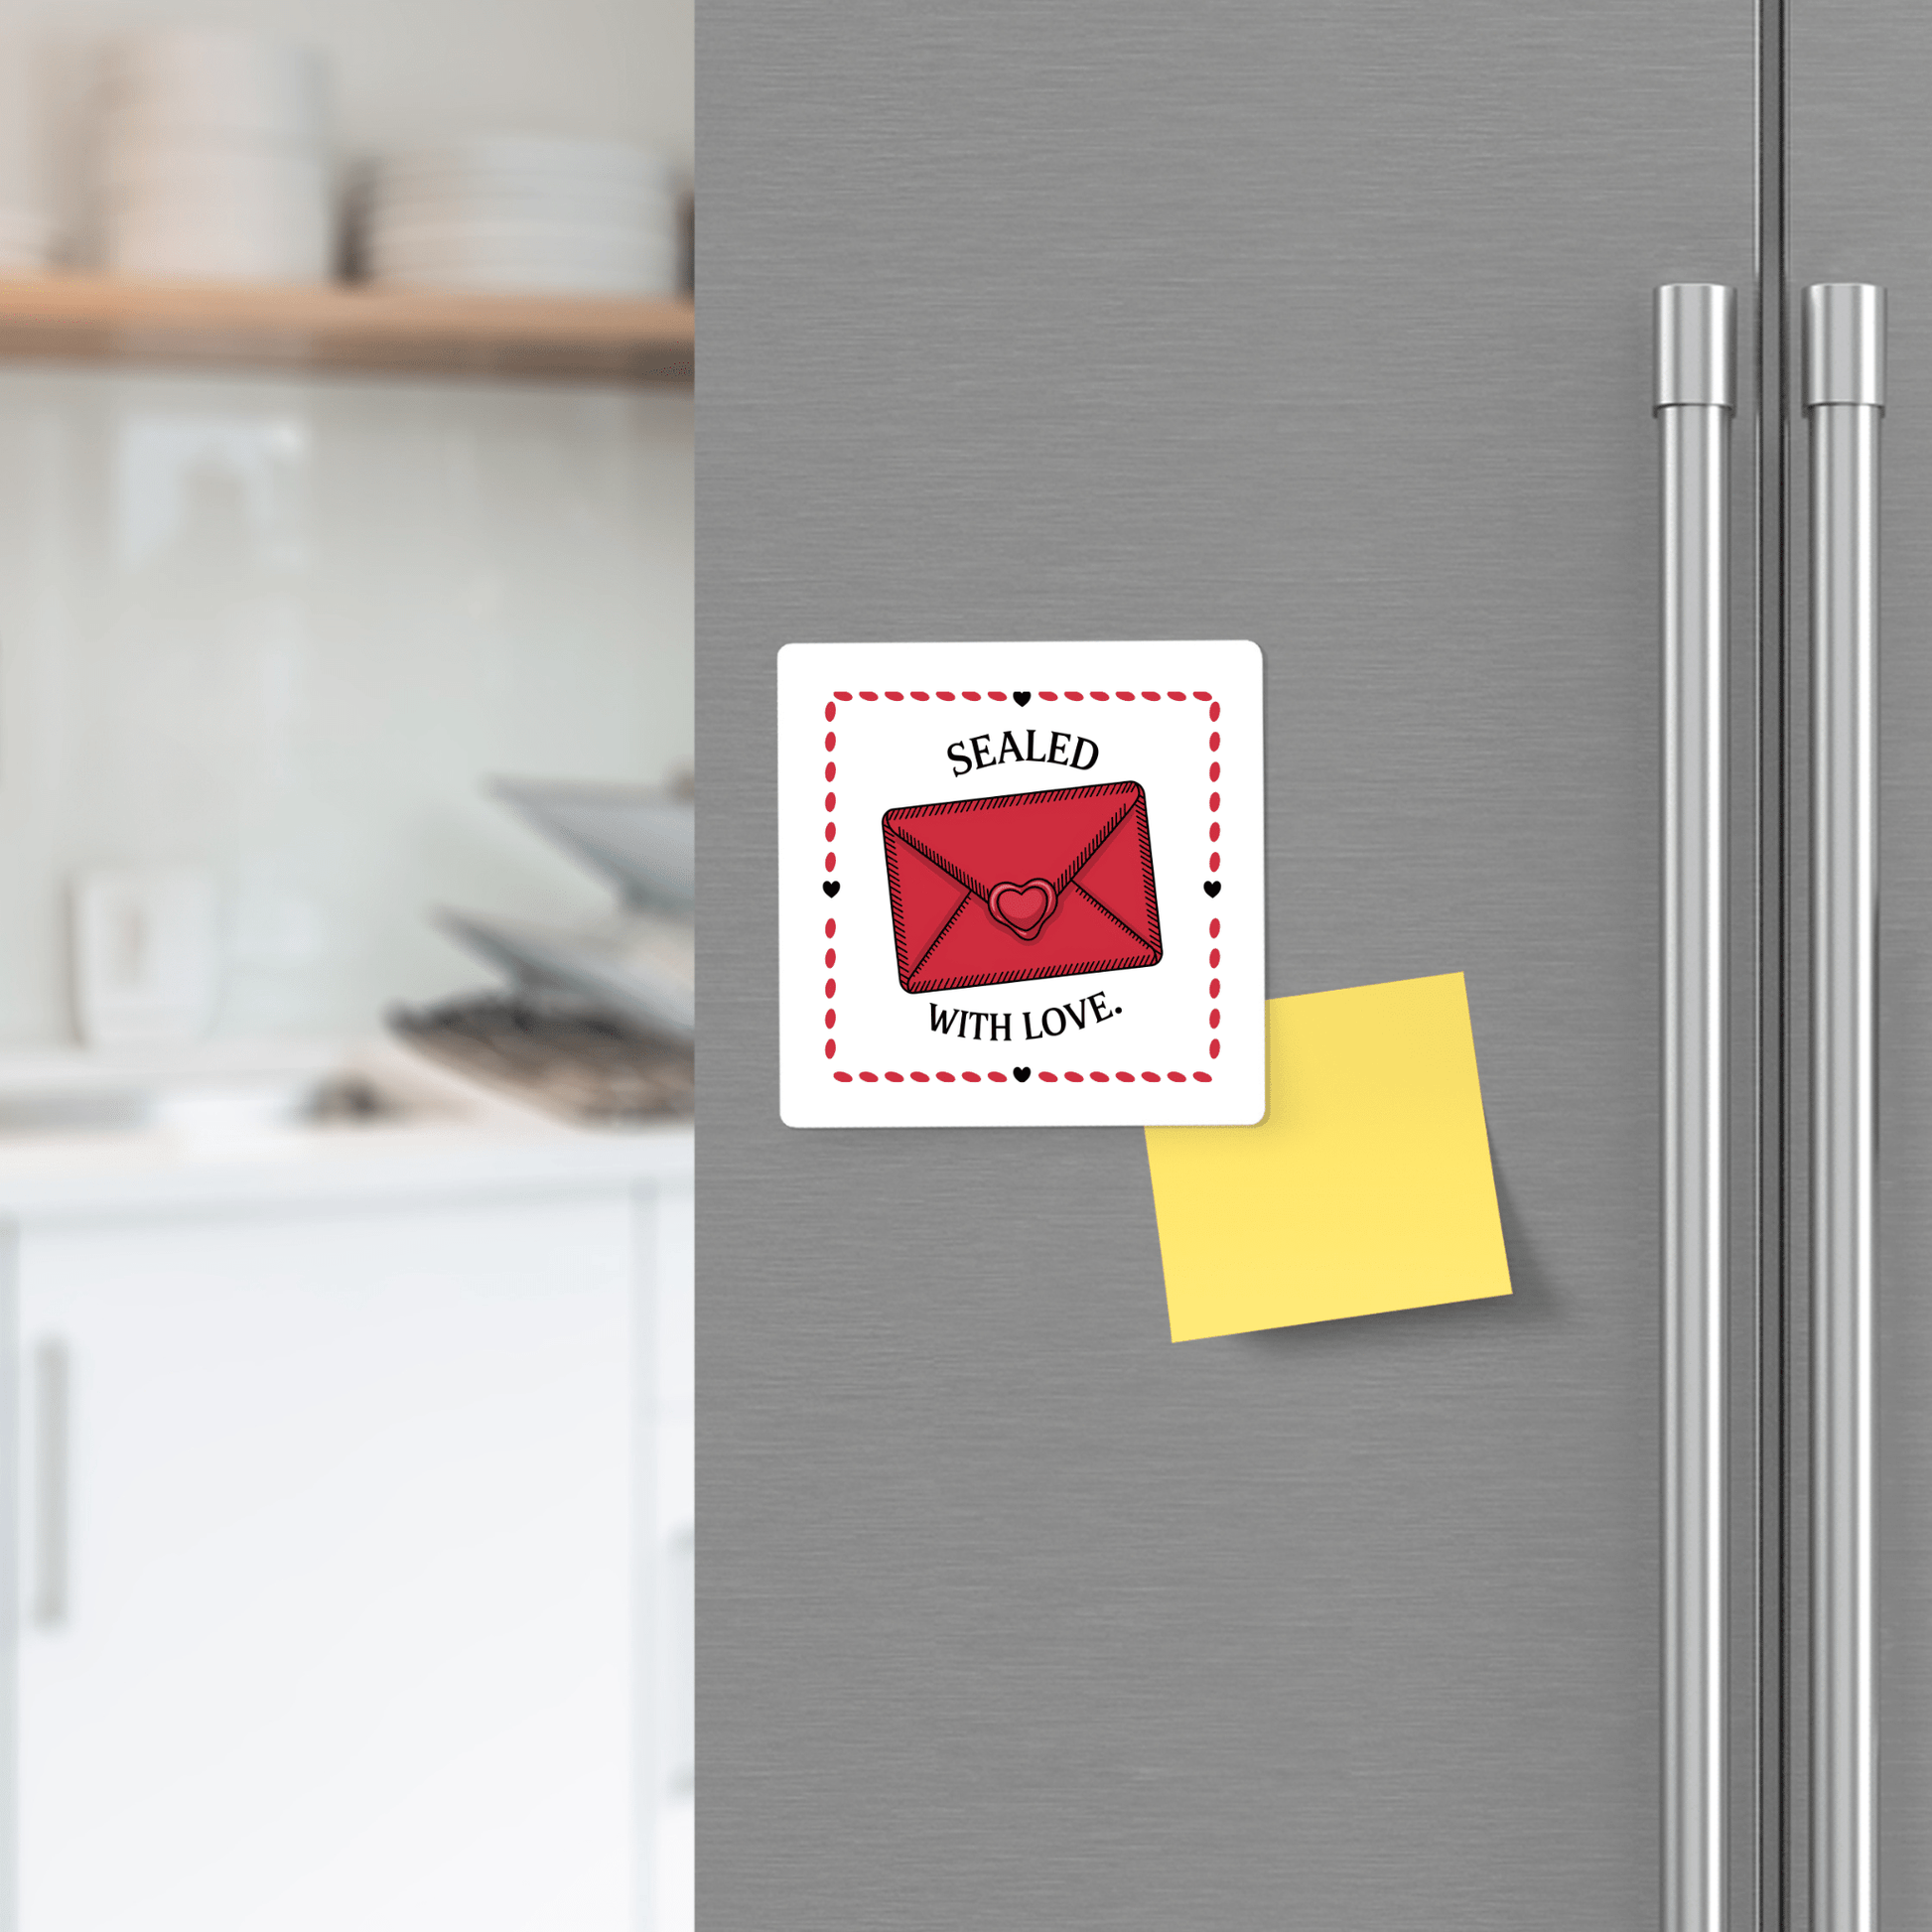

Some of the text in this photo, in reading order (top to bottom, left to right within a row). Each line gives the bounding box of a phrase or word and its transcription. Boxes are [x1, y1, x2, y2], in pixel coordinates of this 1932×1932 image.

[946, 729, 1099, 777] SEALED
[929, 991, 1123, 1041] WITH LOVE.
